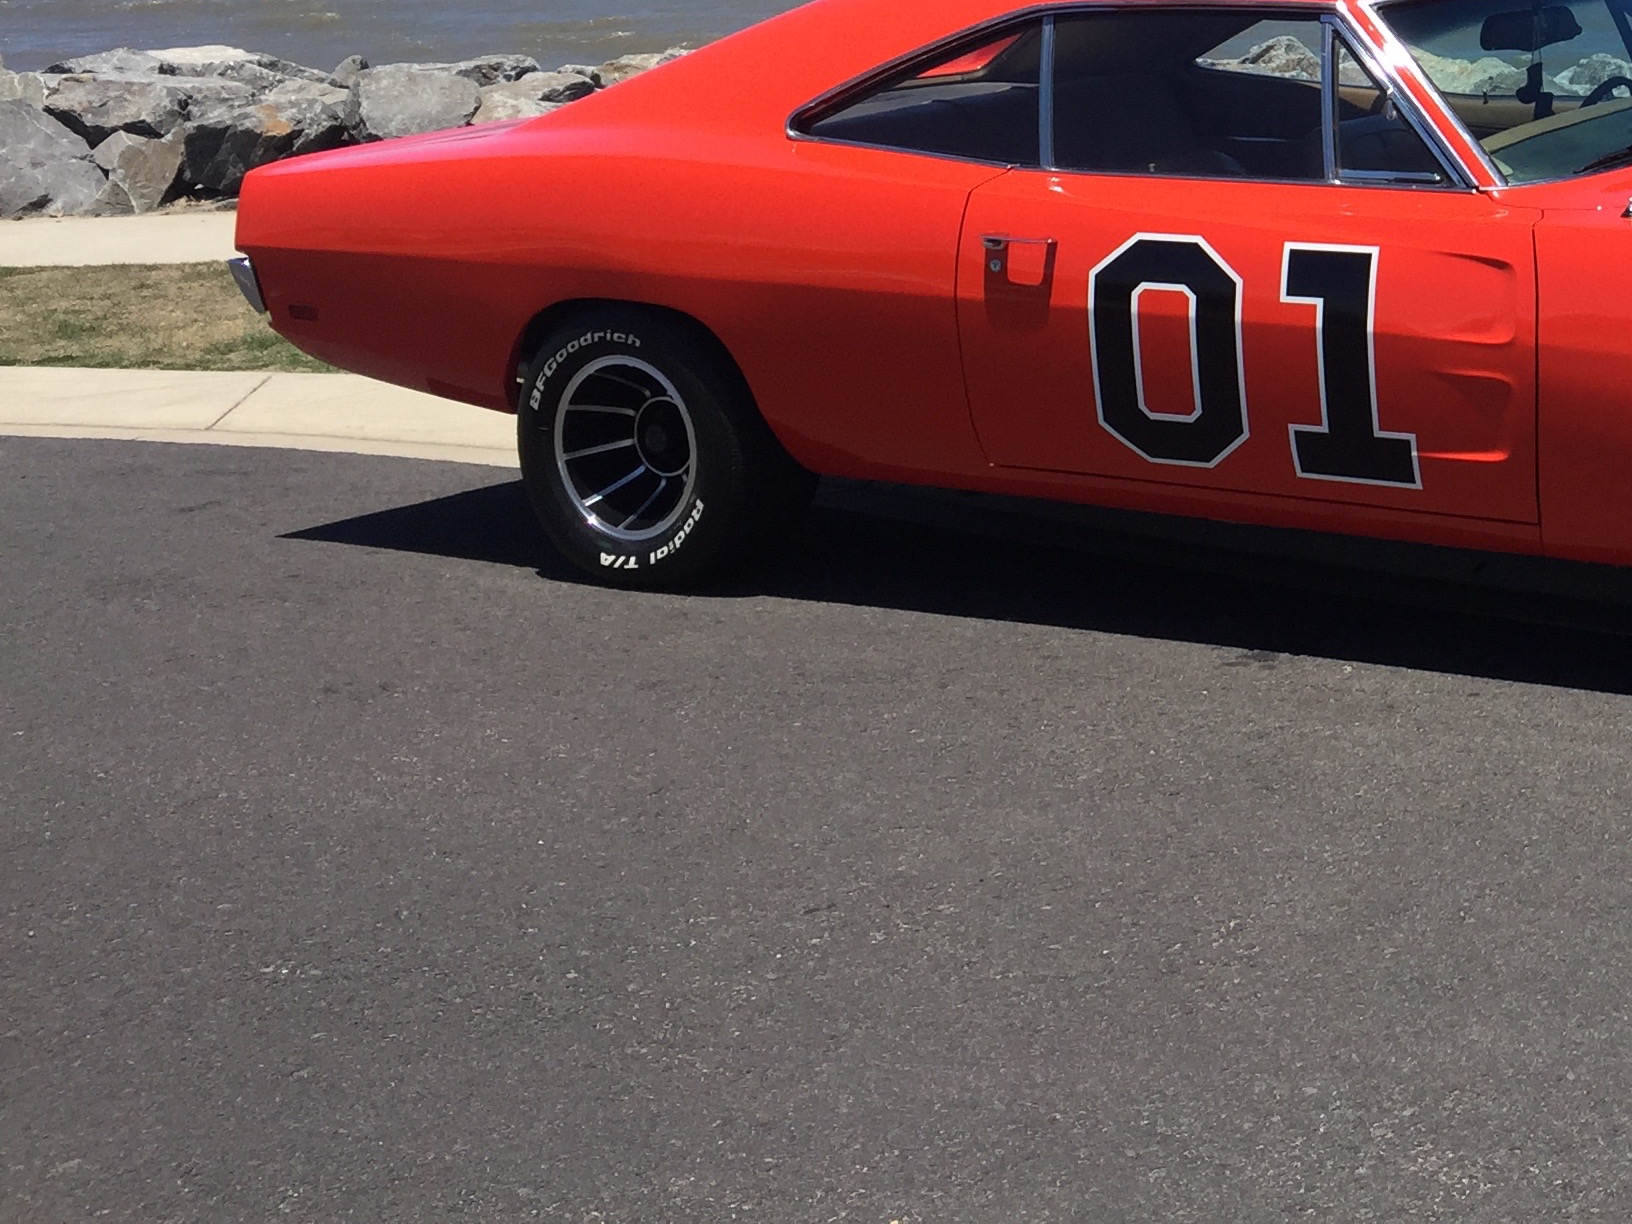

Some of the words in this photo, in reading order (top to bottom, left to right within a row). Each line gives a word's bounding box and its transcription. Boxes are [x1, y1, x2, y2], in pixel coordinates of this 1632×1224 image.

[529, 329, 642, 411] BFGoodrich
[1088, 232, 1423, 490] 01
[599, 551, 639, 570] T/A
[649, 498, 705, 566] Radial
